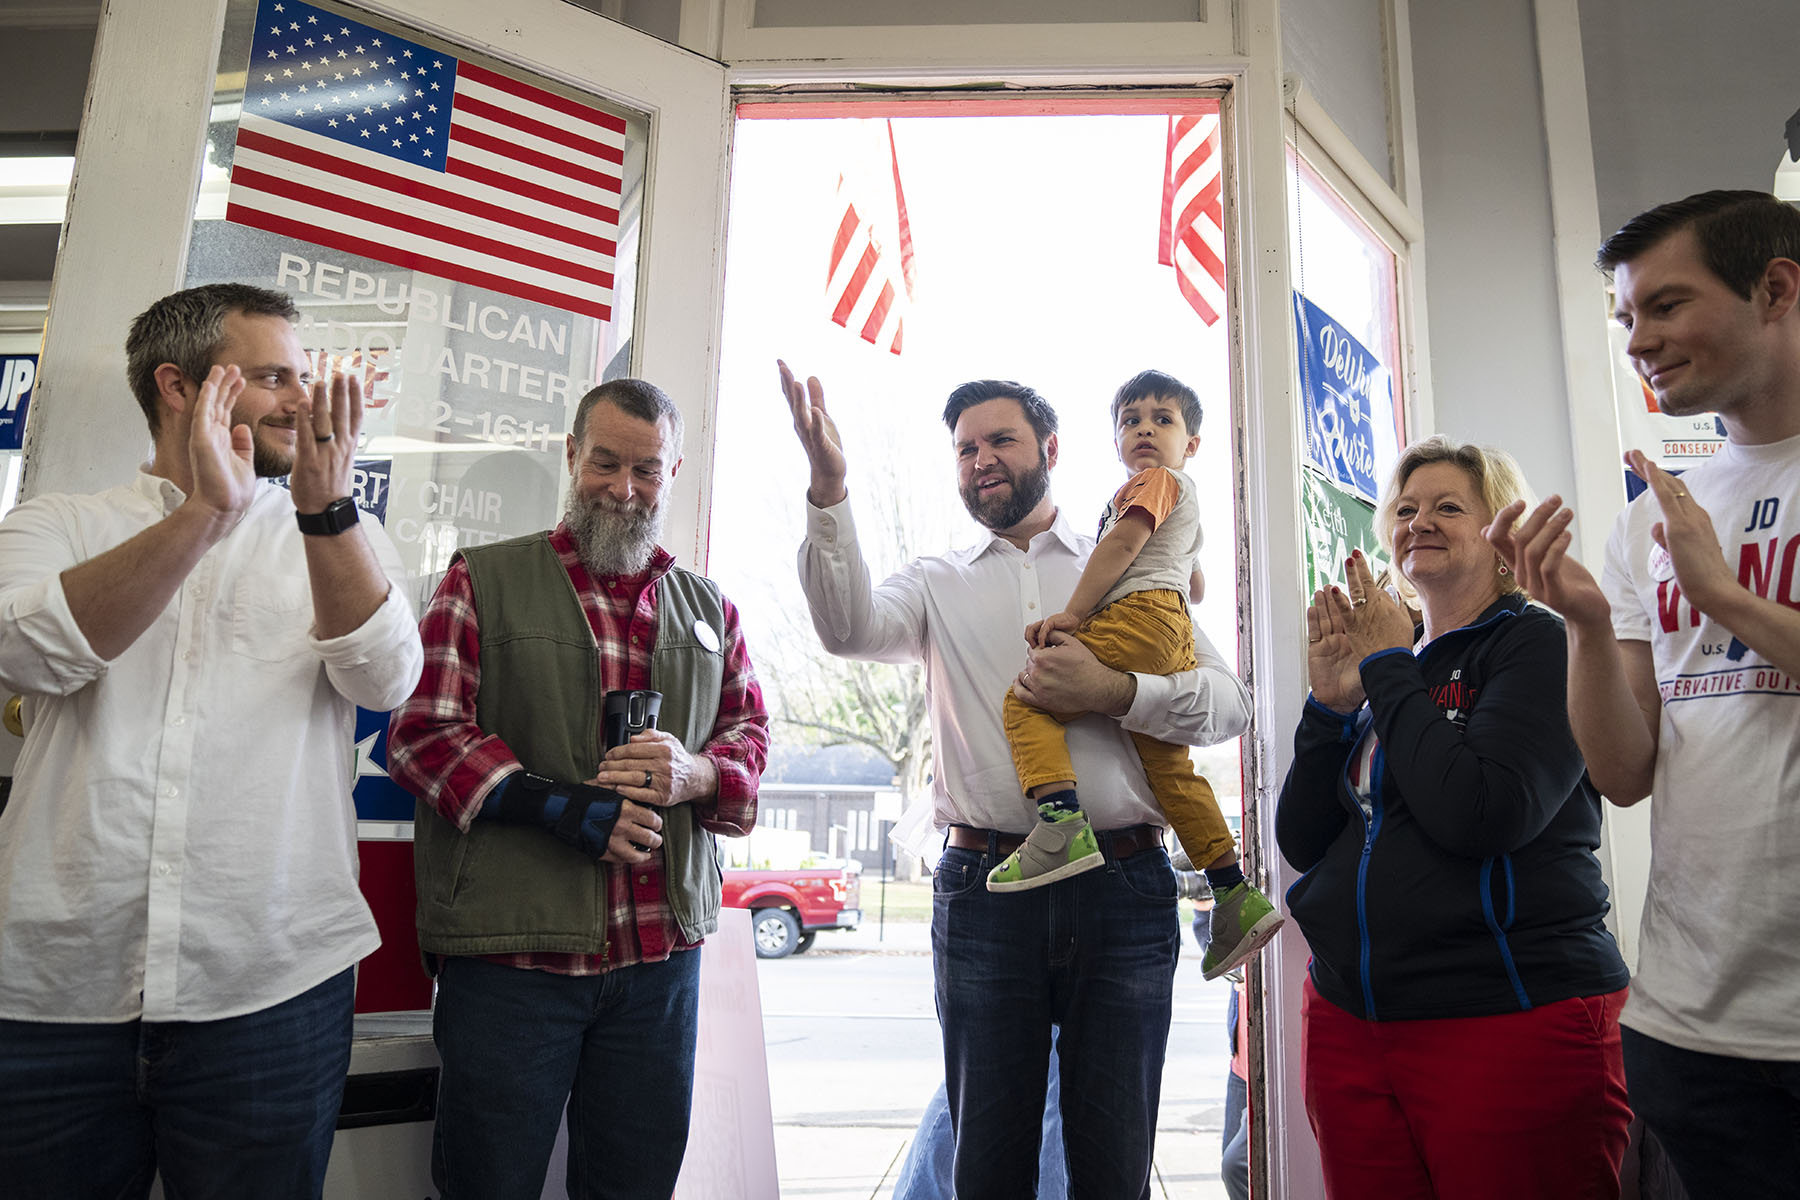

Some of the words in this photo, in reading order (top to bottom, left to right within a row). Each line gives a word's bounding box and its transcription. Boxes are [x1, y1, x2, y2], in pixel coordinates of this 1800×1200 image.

[277, 252, 566, 355] REPUBLICAN
[1693, 422, 1713, 430] U.S.
[418, 480, 502, 523] CHAIR
[1744, 497, 1779, 532] JD
[395, 518, 513, 547] CARTE
[1702, 643, 1725, 656] U.S.
